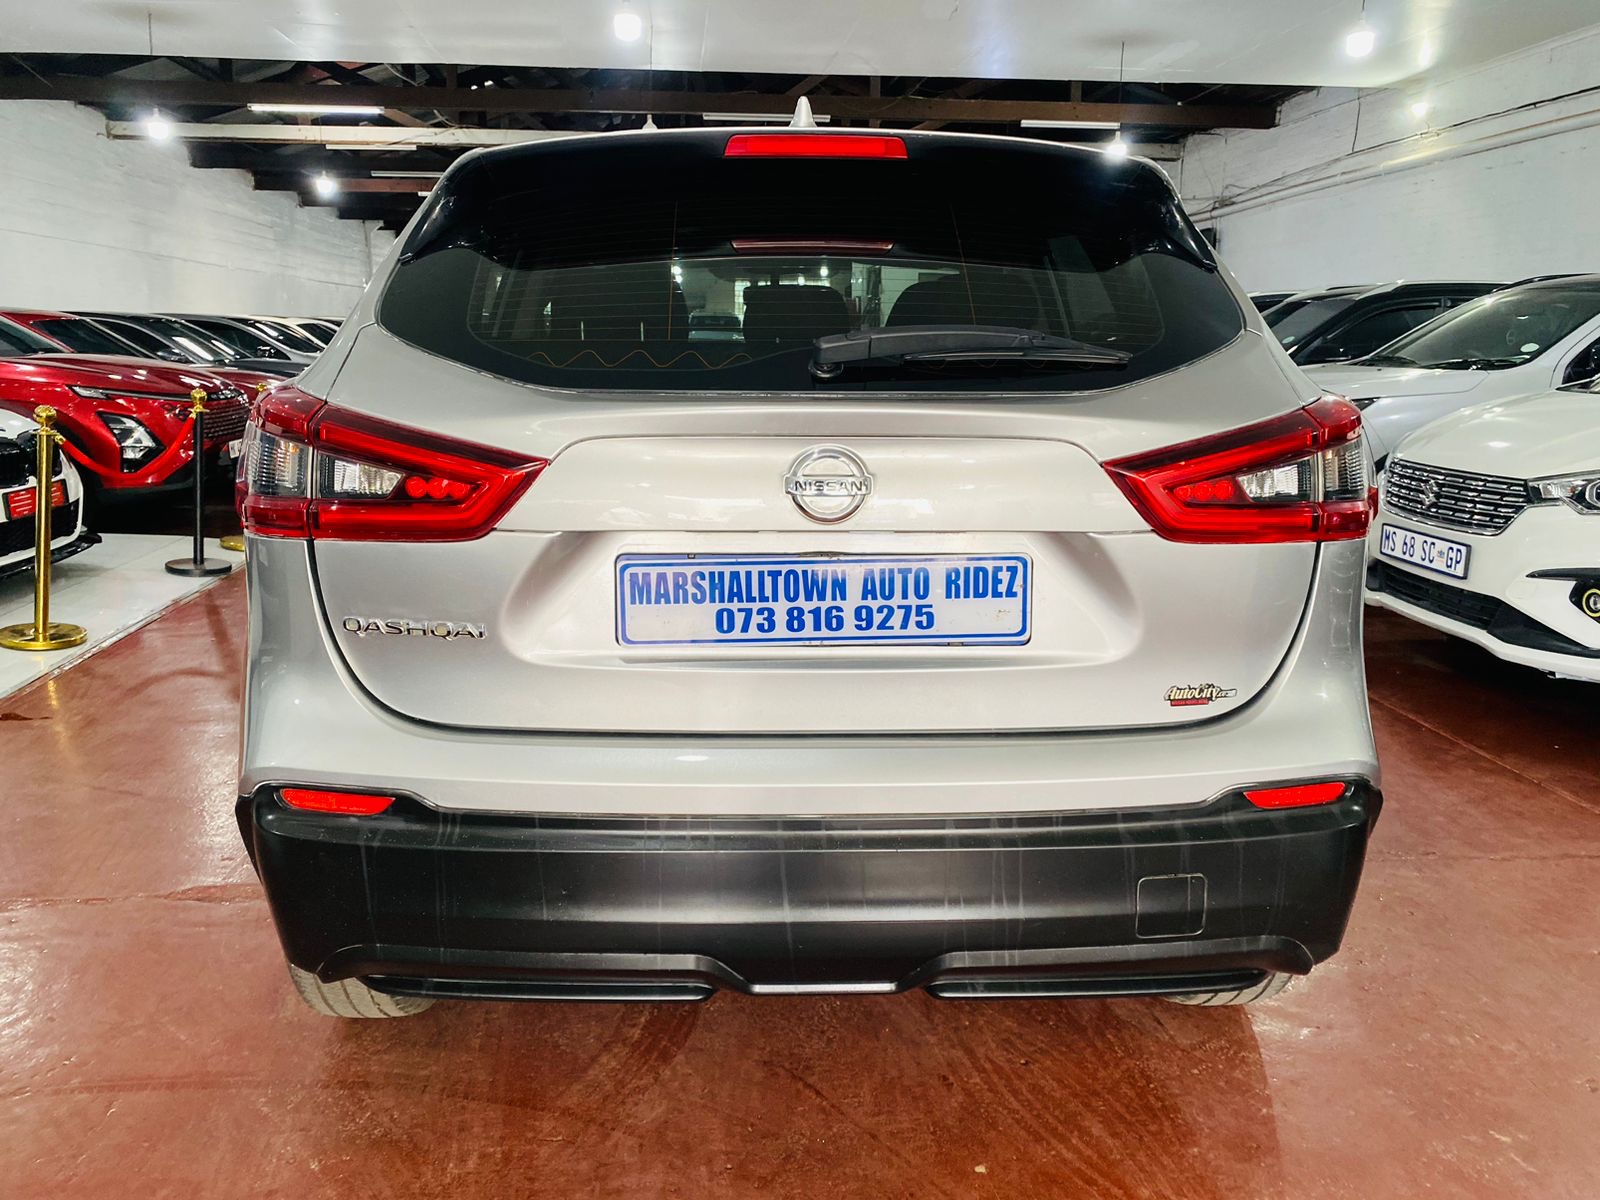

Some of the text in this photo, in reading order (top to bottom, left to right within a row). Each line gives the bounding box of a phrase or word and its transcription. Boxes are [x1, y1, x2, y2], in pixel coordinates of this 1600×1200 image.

[794, 480, 863, 492] NISSAN
[1383, 528, 1462, 571] MS 68 SC GP
[629, 565, 1018, 605] MARSHALLTOWN AUTO RIDEZ
[343, 616, 487, 640] QASHQAI
[715, 604, 935, 634] 073 816 9275
